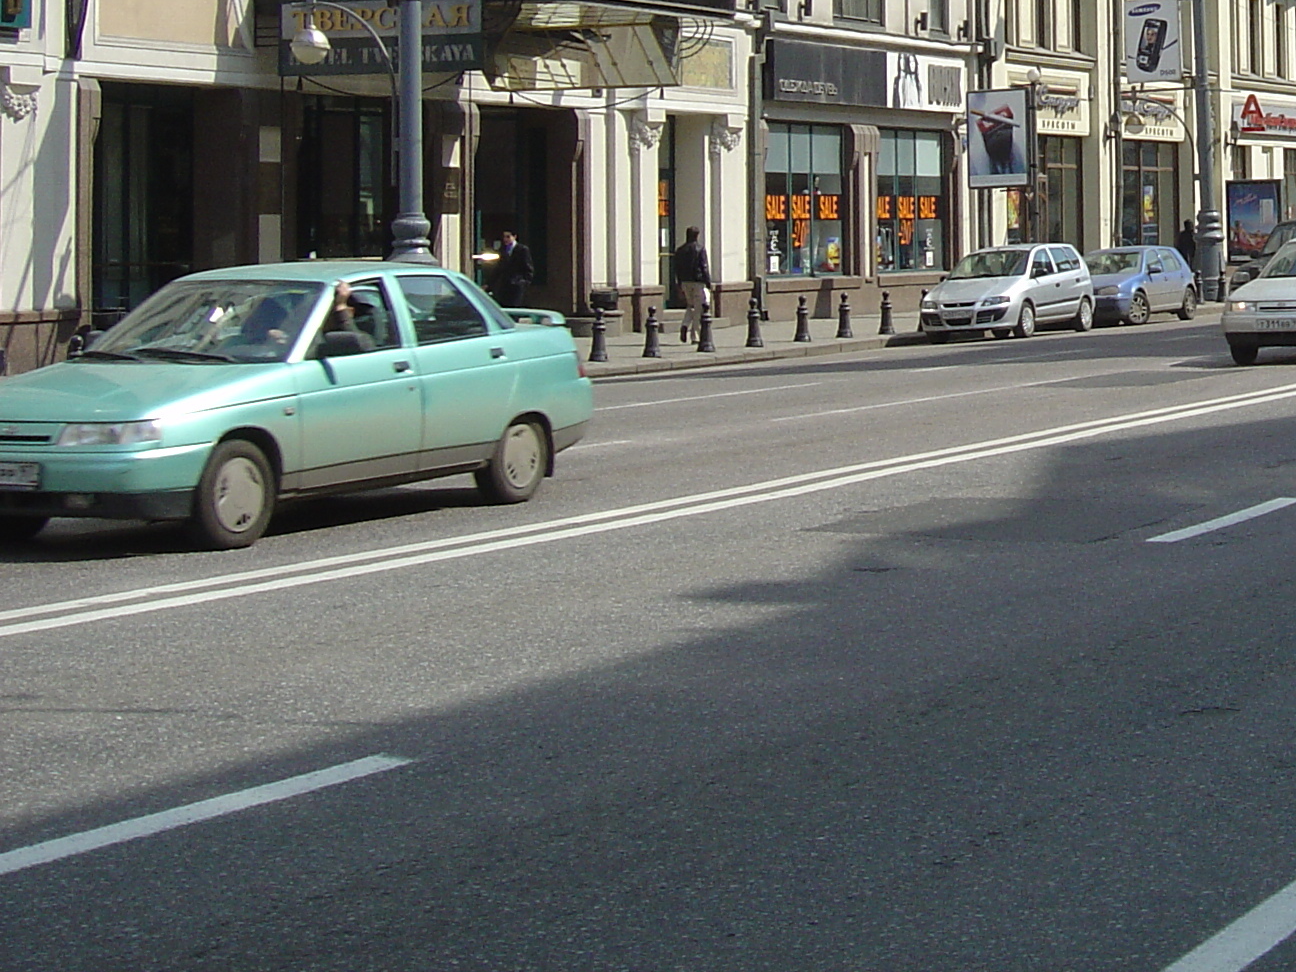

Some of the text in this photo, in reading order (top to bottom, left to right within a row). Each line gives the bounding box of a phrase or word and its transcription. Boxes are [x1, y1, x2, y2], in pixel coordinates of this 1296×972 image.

[292, 3, 471, 32] ТВЕРСАЯ
[767, 195, 786, 220] SALE
[792, 195, 811, 220] SALE
[819, 195, 838, 220] SALE
[898, 196, 915, 219] SALE
[920, 196, 936, 219] SALE
